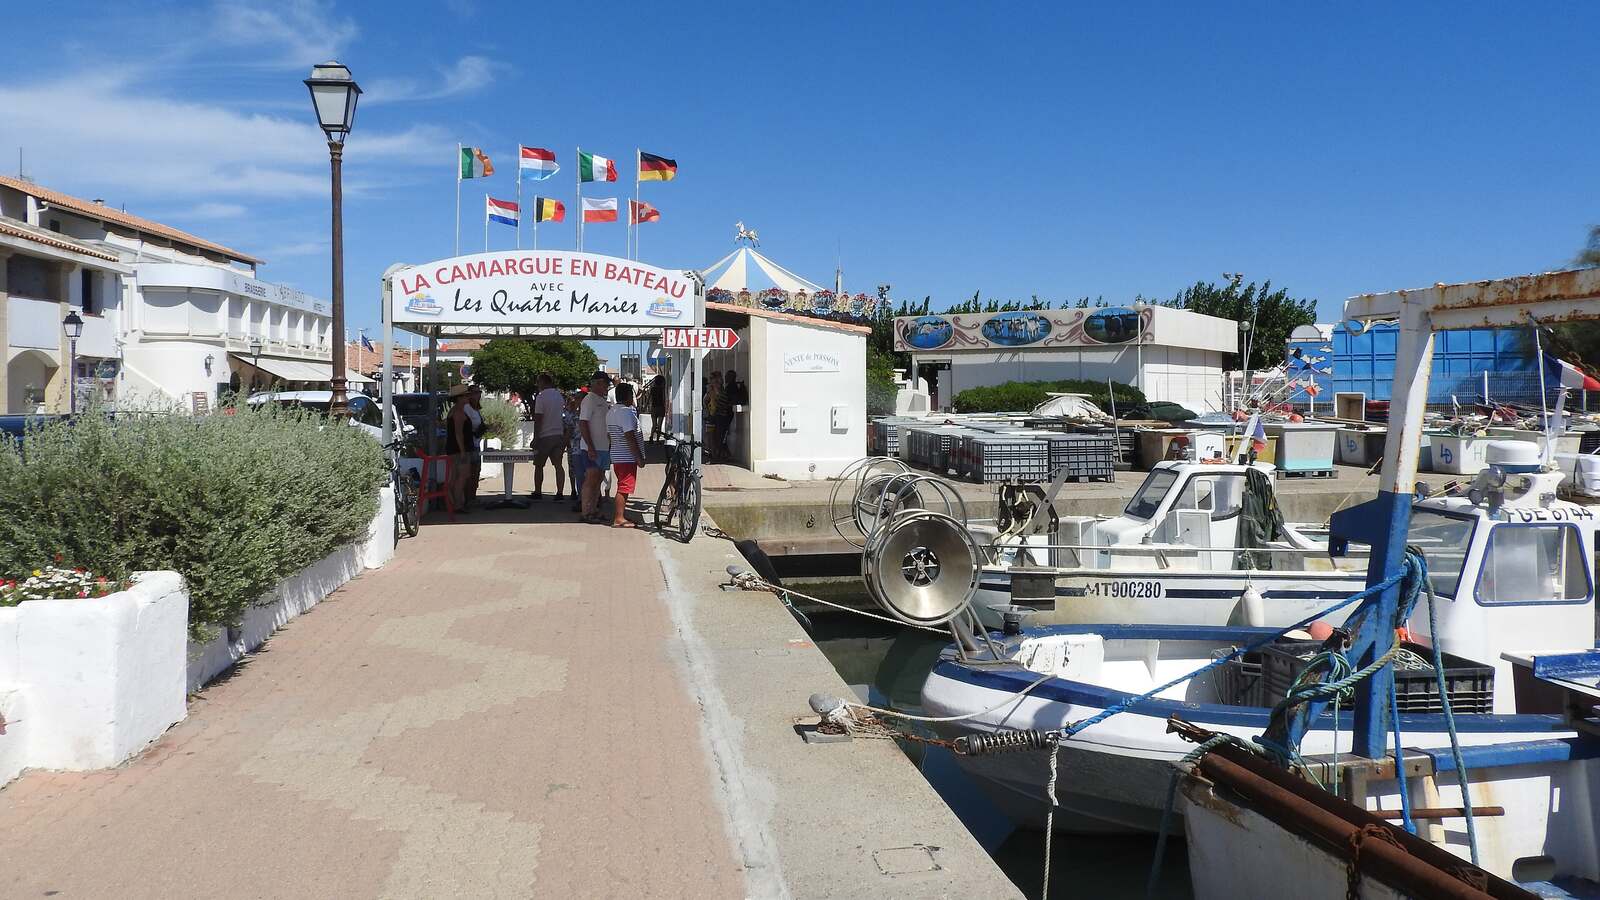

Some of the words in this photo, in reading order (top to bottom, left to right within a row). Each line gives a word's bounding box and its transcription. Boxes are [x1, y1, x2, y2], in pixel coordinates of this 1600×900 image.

[401, 273, 431, 295] LA
[435, 257, 563, 285] CAMARGUE
[570, 258, 598, 278] EN
[604, 263, 687, 299] BATEAU
[530, 282, 564, 292] AVEC
[453, 288, 482, 313] Les
[491, 289, 561, 316] Quatre
[569, 290, 638, 315] Maries
[666, 329, 729, 348] BATEAU
